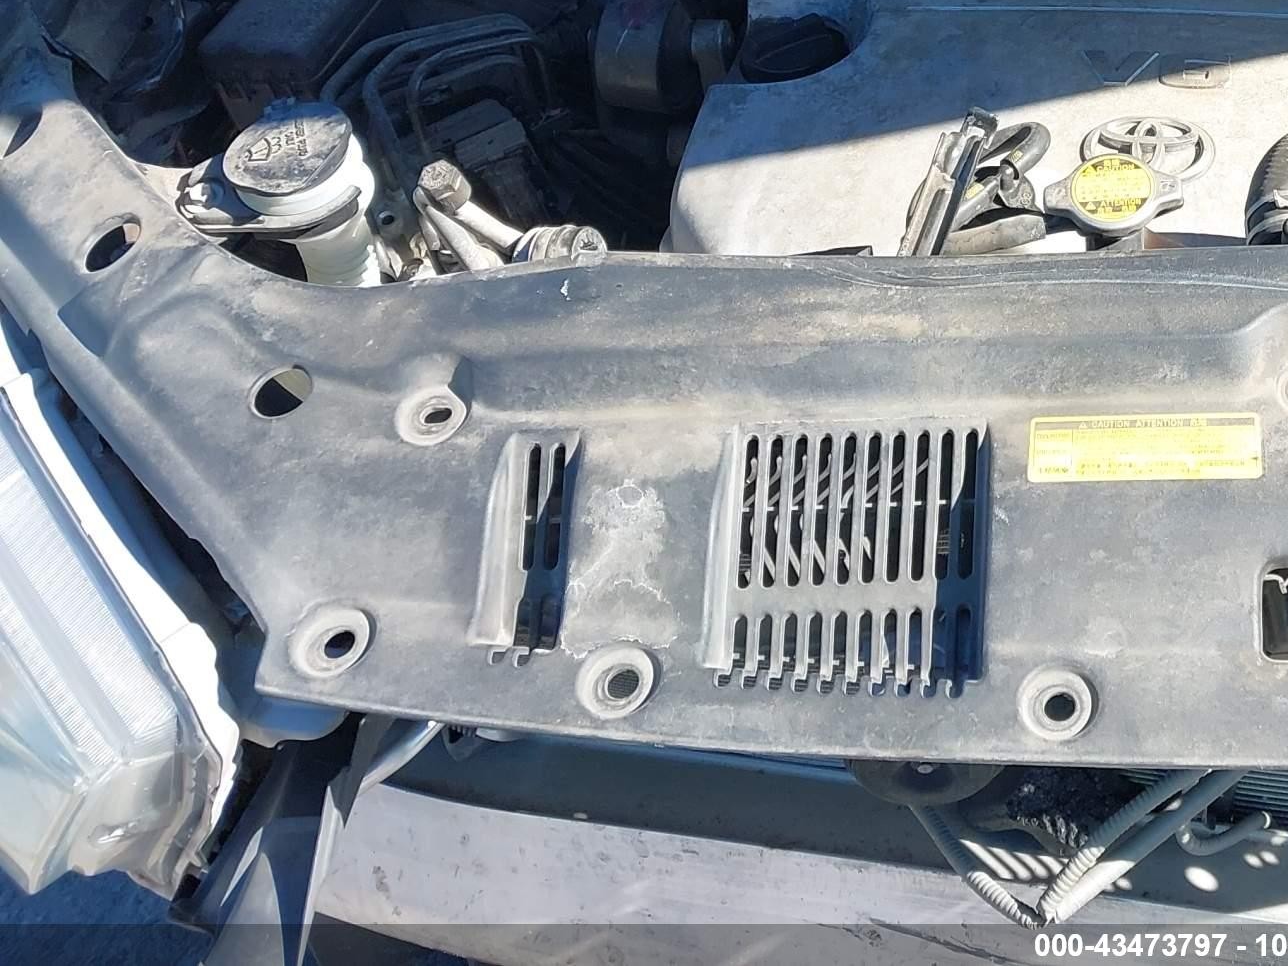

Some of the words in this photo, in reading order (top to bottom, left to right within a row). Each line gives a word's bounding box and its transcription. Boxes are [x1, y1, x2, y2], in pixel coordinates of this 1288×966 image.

[1100, 197, 1142, 208] ATTENTION
[1091, 419, 1131, 429] CAUTION
[1135, 418, 1185, 428] ATTENTION
